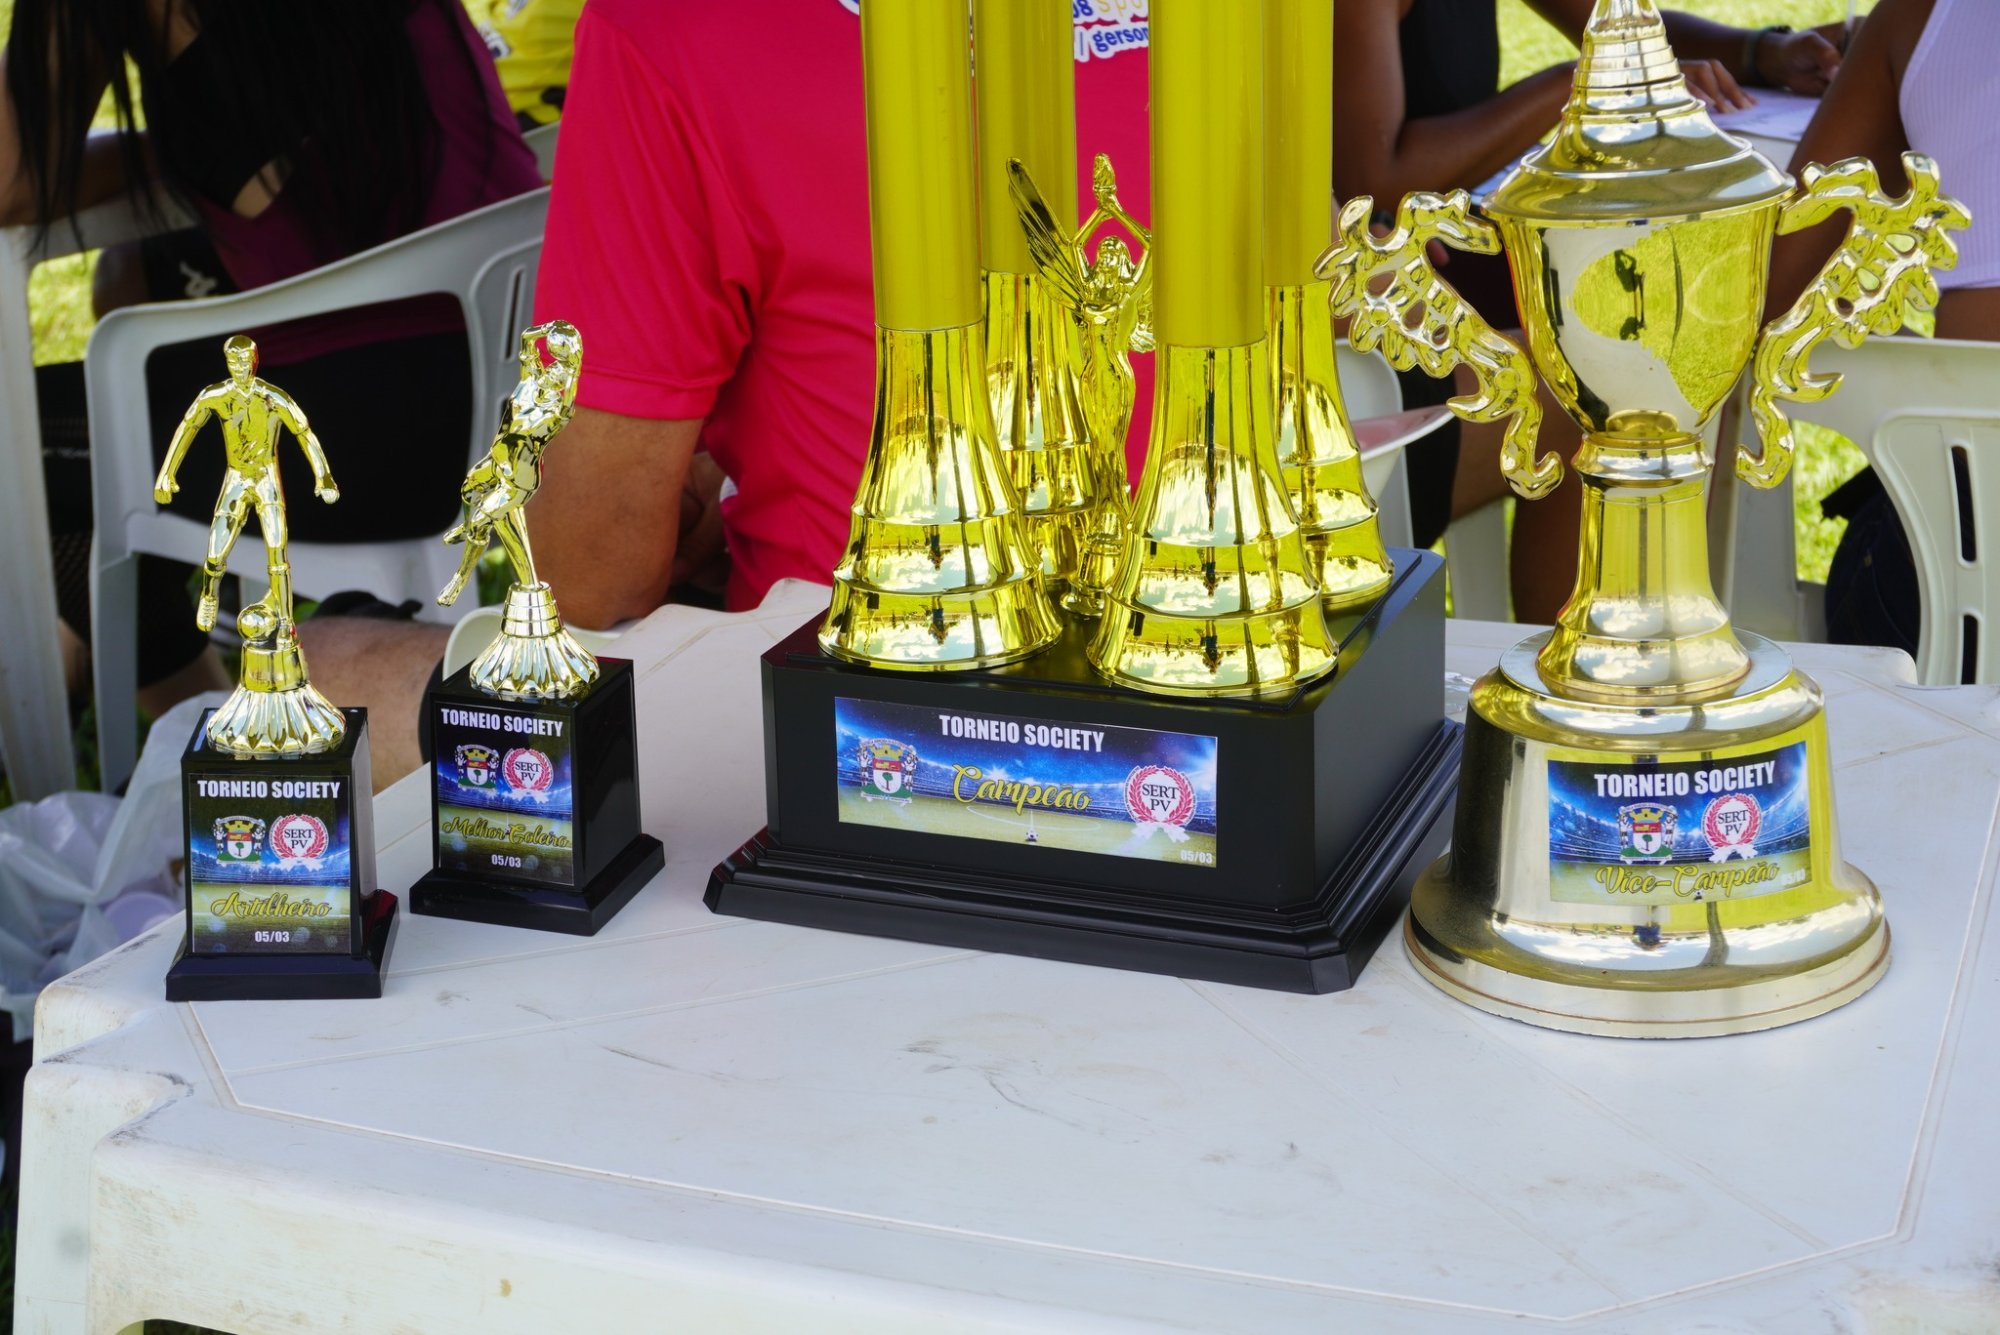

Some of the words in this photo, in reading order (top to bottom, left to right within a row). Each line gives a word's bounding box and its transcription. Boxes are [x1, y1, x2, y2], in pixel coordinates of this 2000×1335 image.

[441, 708, 500, 731] TORNEIO
[503, 715, 563, 737] SOCIETY
[939, 715, 1019, 744] TORNEIO
[1024, 724, 1105, 752] SOCIETY
[514, 761, 541, 773] SERT
[521, 772, 536, 782] PV
[1594, 772, 1689, 797] TORNEIO
[1694, 760, 1775, 794] SOCIETY
[197, 780, 268, 798] TORNEIO
[271, 781, 340, 799] SOCIETY
[952, 763, 1093, 815] Campeão
[1142, 783, 1179, 799] SERT
[1150, 799, 1171, 812] PV
[1717, 809, 1749, 825] SERT
[284, 828, 314, 839] SERT
[442, 816, 505, 839] Melhor
[508, 824, 570, 848] Goleiro
[1725, 823, 1742, 836] PV
[291, 839, 308, 849] PV
[491, 854, 521, 868] 05/03
[1180, 850, 1213, 865] 05/03
[1595, 861, 1780, 897] Vice-Campeão
[211, 891, 332, 918] Artilheiro
[254, 930, 290, 943] 05/03
